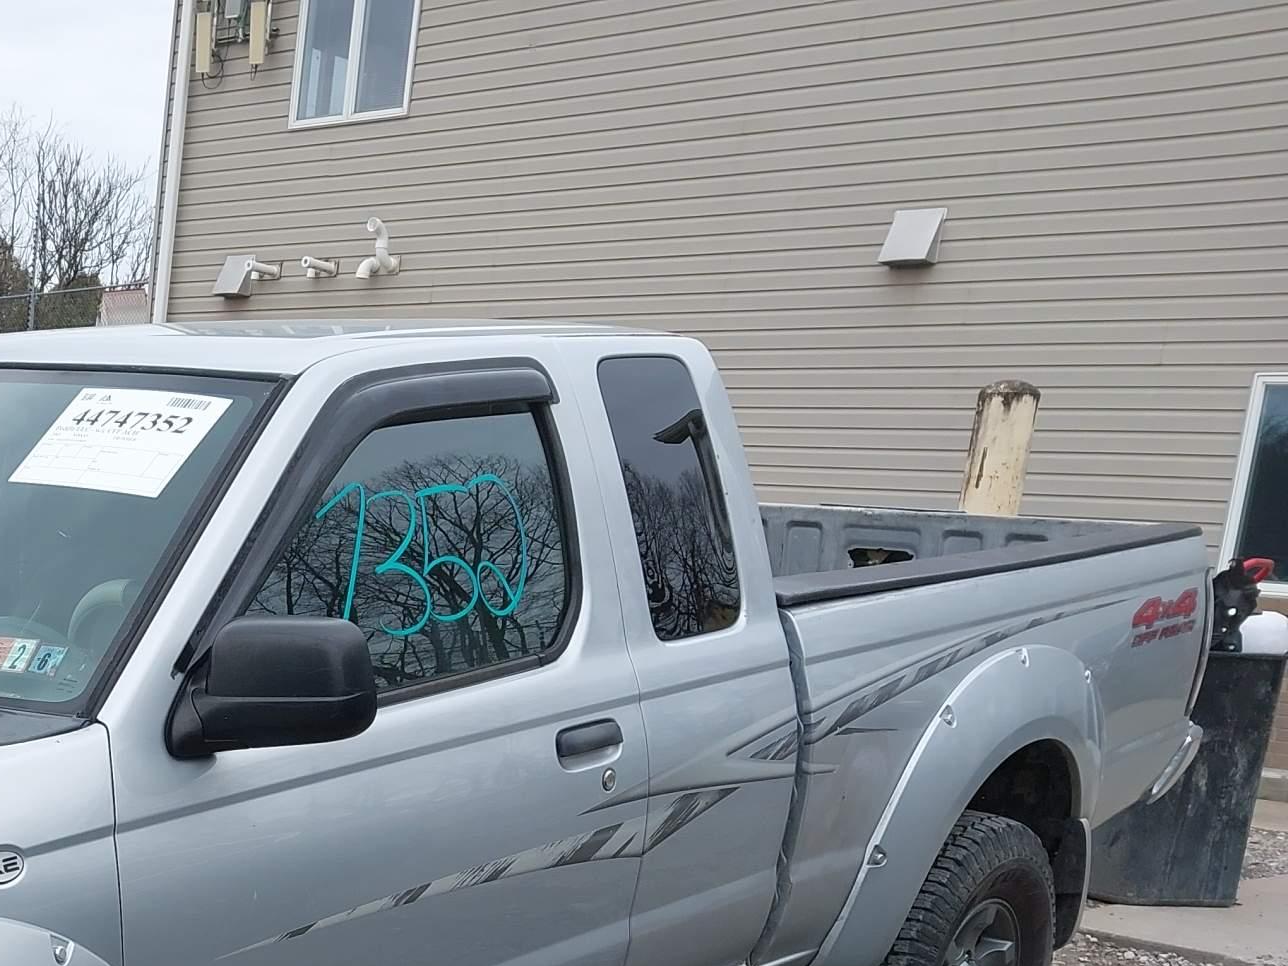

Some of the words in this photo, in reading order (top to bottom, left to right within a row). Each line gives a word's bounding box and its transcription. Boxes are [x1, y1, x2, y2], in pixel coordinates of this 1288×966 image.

[72, 408, 194, 434] 44747352
[315, 472, 528, 636] 1350
[8, 644, 27, 670] 2
